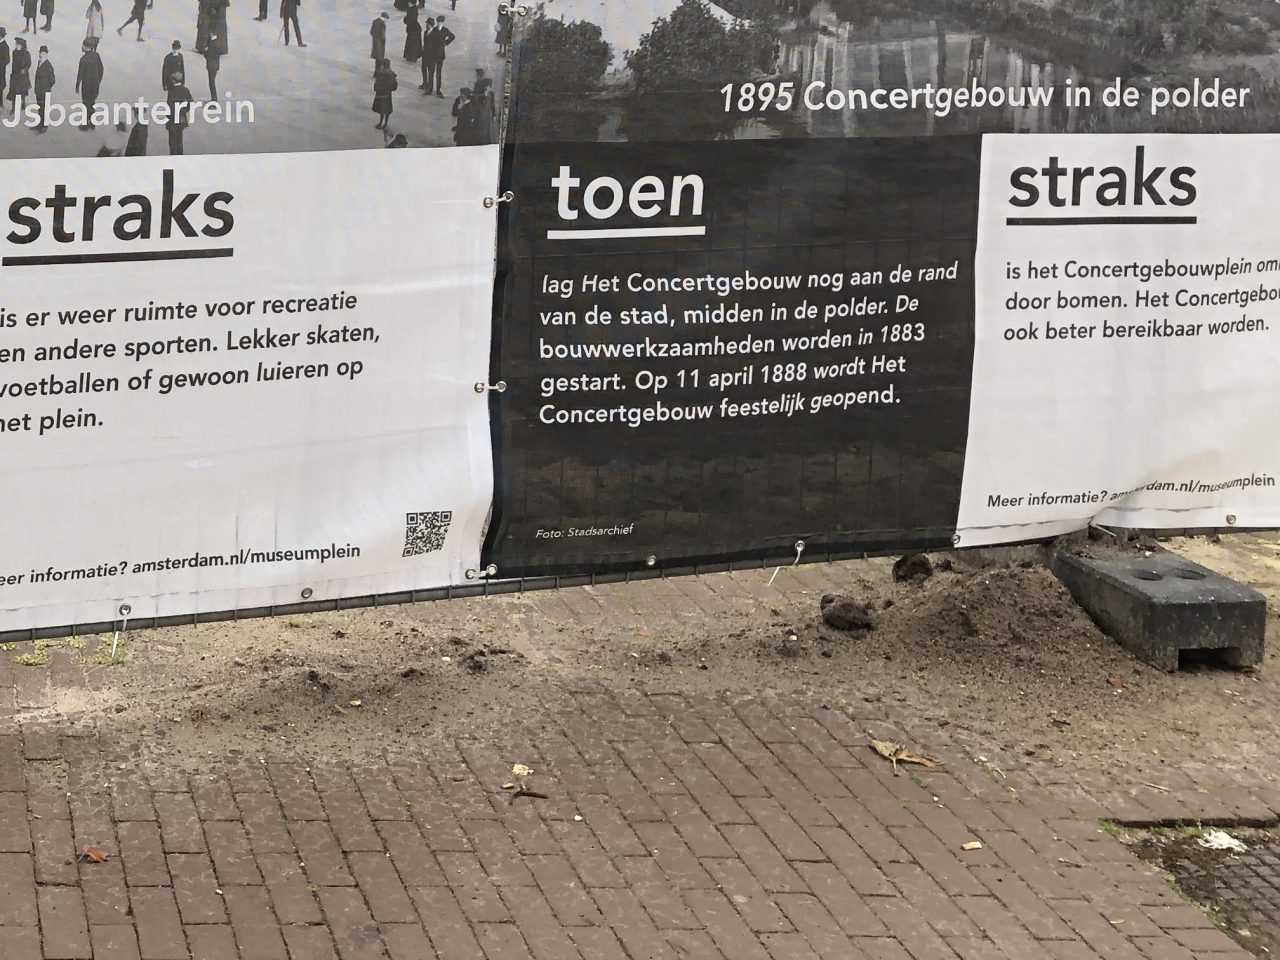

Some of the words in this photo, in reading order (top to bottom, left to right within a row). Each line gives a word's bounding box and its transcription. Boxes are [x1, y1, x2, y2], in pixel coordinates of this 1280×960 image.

[720, 81, 793, 112] 1895
[804, 76, 1055, 118] Concertgebouw
[1063, 78, 1092, 109] in
[1102, 76, 1140, 109] de
[1151, 78, 1250, 114] polder
[551, 165, 704, 221] toen
[1008, 145, 1197, 208] straks
[5, 168, 235, 245] straks
[542, 274, 574, 299] lag
[581, 274, 620, 293] Het
[627, 269, 802, 297] Concertgebouw
[807, 272, 844, 292] nog
[850, 271, 883, 286] aan
[889, 263, 913, 284] de
[918, 260, 959, 282] rand
[1006, 261, 1021, 280] is
[1027, 260, 1059, 280] het
[1064, 256, 1252, 283] Concertgebouwplein
[1256, 259, 1280, 273] om
[0, 307, 18, 328] is
[25, 311, 51, 327] er
[57, 308, 117, 326] weer
[124, 300, 198, 323] ruimte
[204, 300, 256, 317] voor
[262, 290, 358, 315] recreatie
[539, 311, 576, 326] van
[584, 304, 612, 325] de
[620, 303, 675, 328] stad,
[683, 302, 764, 324] midden
[770, 302, 787, 321] in
[794, 299, 818, 320] de
[824, 295, 888, 323] polder.
[895, 294, 919, 313] De
[1005, 291, 1052, 311] door
[1056, 290, 1128, 309] bomen.
[1135, 289, 1170, 308] Het
[1174, 283, 1280, 308] Concertgebo
[34, 337, 117, 362] andere
[124, 335, 218, 362] sporten.
[226, 327, 301, 351] Lekker
[306, 323, 380, 346] skaten,
[539, 333, 775, 359] bouwwerkzaamheden
[781, 328, 852, 352] worden
[857, 327, 874, 346] in
[881, 322, 925, 343] 1883
[1003, 321, 1039, 341] ook
[1045, 320, 1097, 340] beter
[1102, 318, 1204, 338] bereikbaar
[1207, 313, 1270, 335] worden.
[127, 368, 154, 391] of
[158, 369, 249, 395] gewoon
[256, 361, 329, 382] luieren
[336, 360, 364, 381] op
[540, 373, 627, 398] gestart.
[634, 370, 668, 395] Op
[676, 368, 699, 388] 11
[708, 364, 754, 392] april
[760, 362, 807, 384] 1888
[813, 356, 866, 380] wordt
[871, 354, 906, 374] Het
[39, 407, 104, 436] plein.
[539, 400, 714, 428] Concertgebouw
[719, 391, 806, 418] feestelijk
[809, 383, 901, 414] geopend.
[987, 494, 1025, 508] Meer
[1027, 489, 1108, 506] informatie?
[535, 529, 562, 539] Foto:
[567, 522, 635, 537] Stadsarchief
[30, 560, 128, 584] informatie?
[131, 542, 361, 574] amsterdam.nl/museumplein
